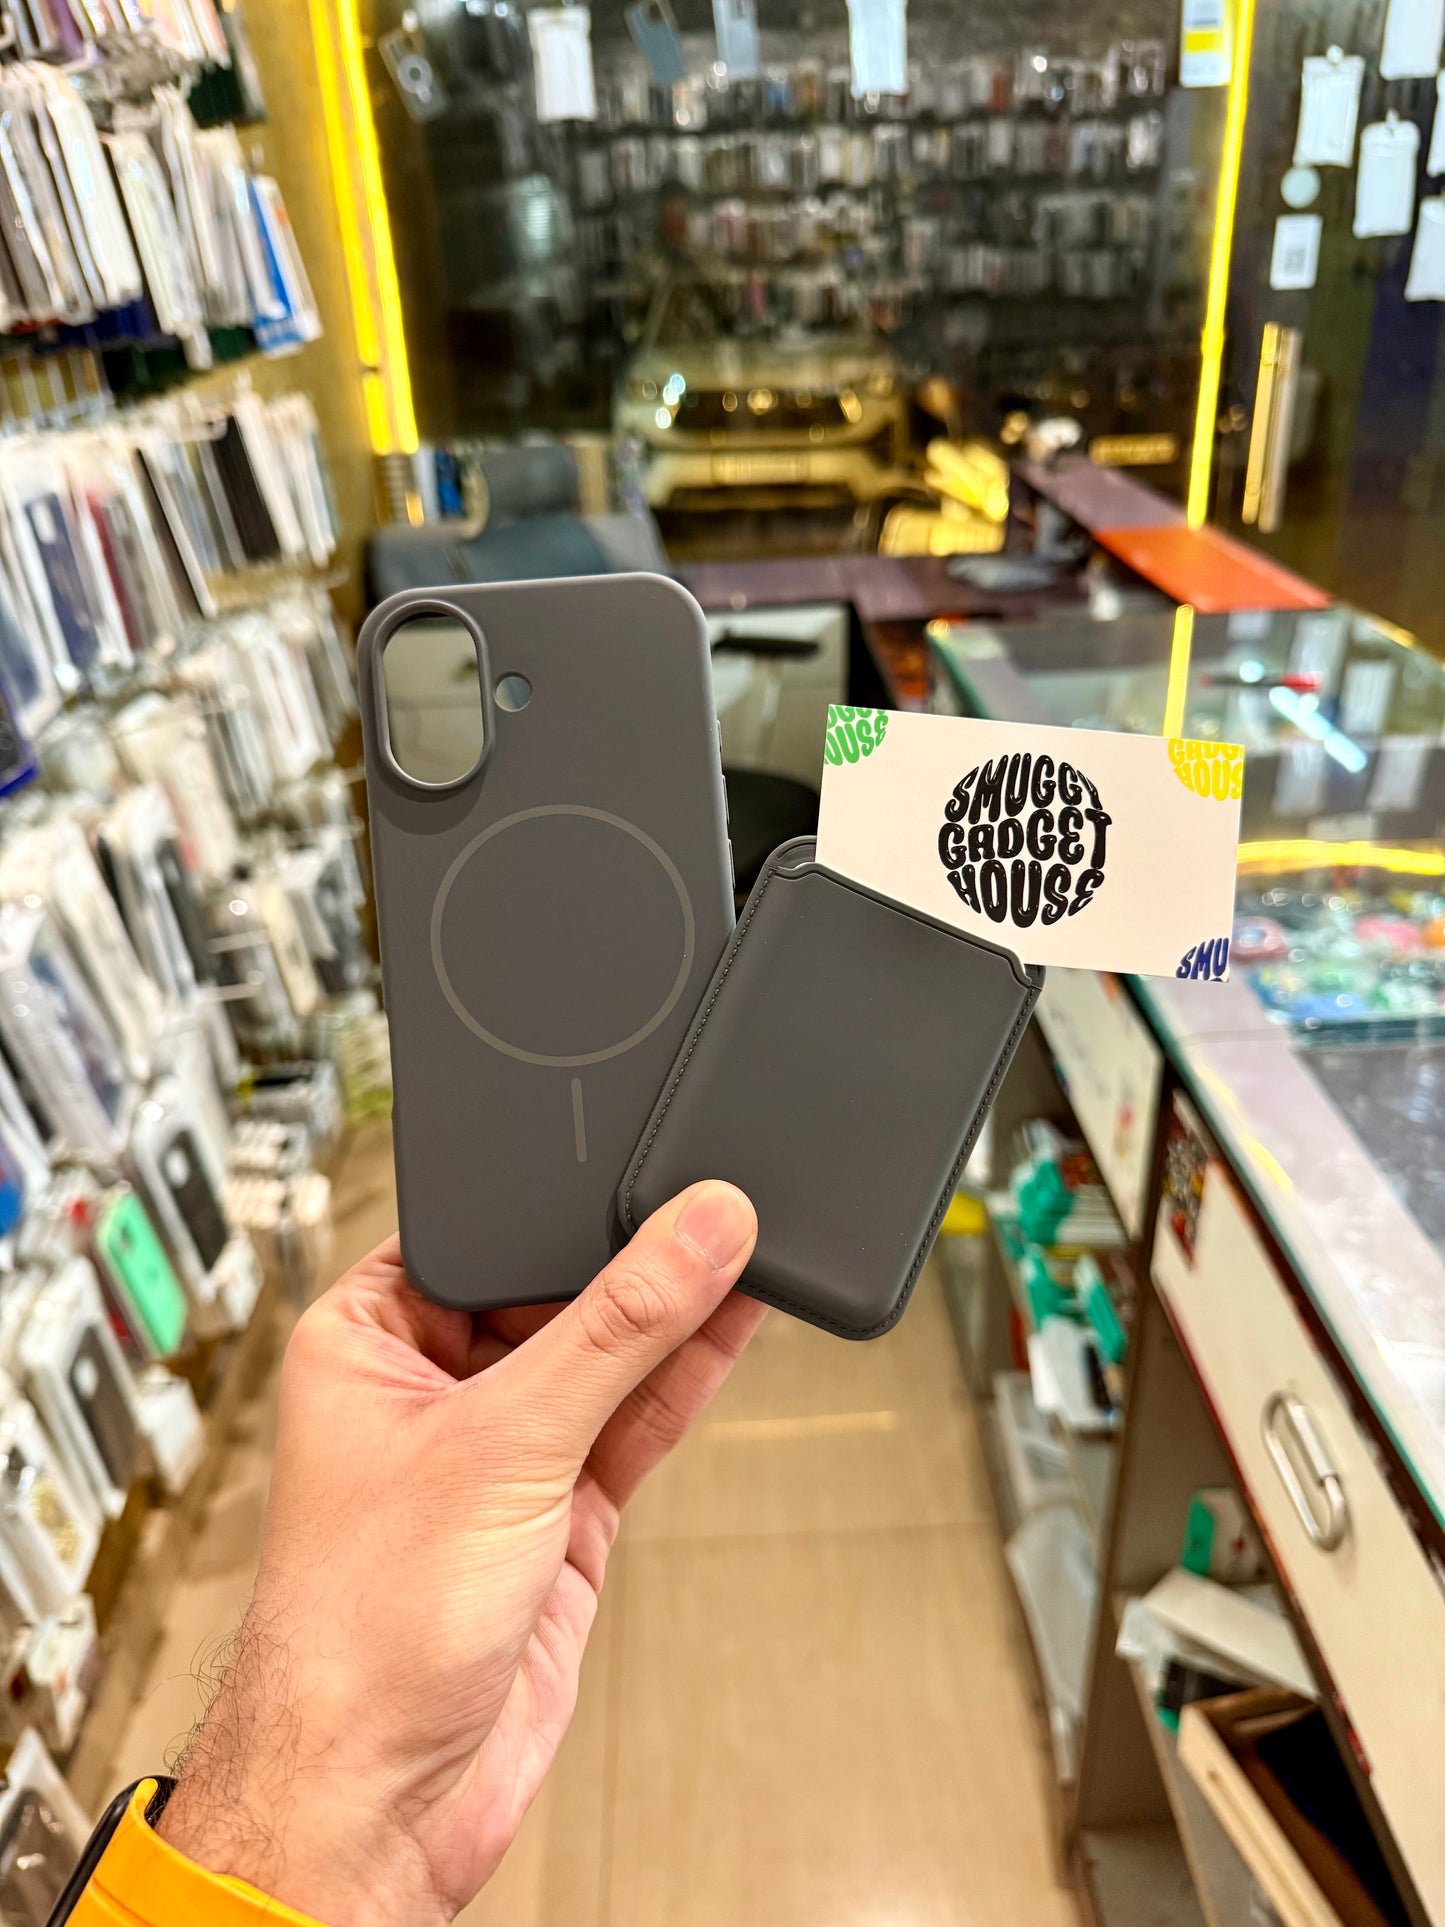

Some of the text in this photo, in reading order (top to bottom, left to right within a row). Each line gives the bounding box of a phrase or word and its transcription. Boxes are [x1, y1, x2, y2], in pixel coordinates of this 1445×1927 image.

[824, 715, 889, 767] OUSE
[944, 752, 1103, 824] SMUGGY
[938, 806, 1113, 870] GADGET
[947, 859, 1105, 928] HOUSE
